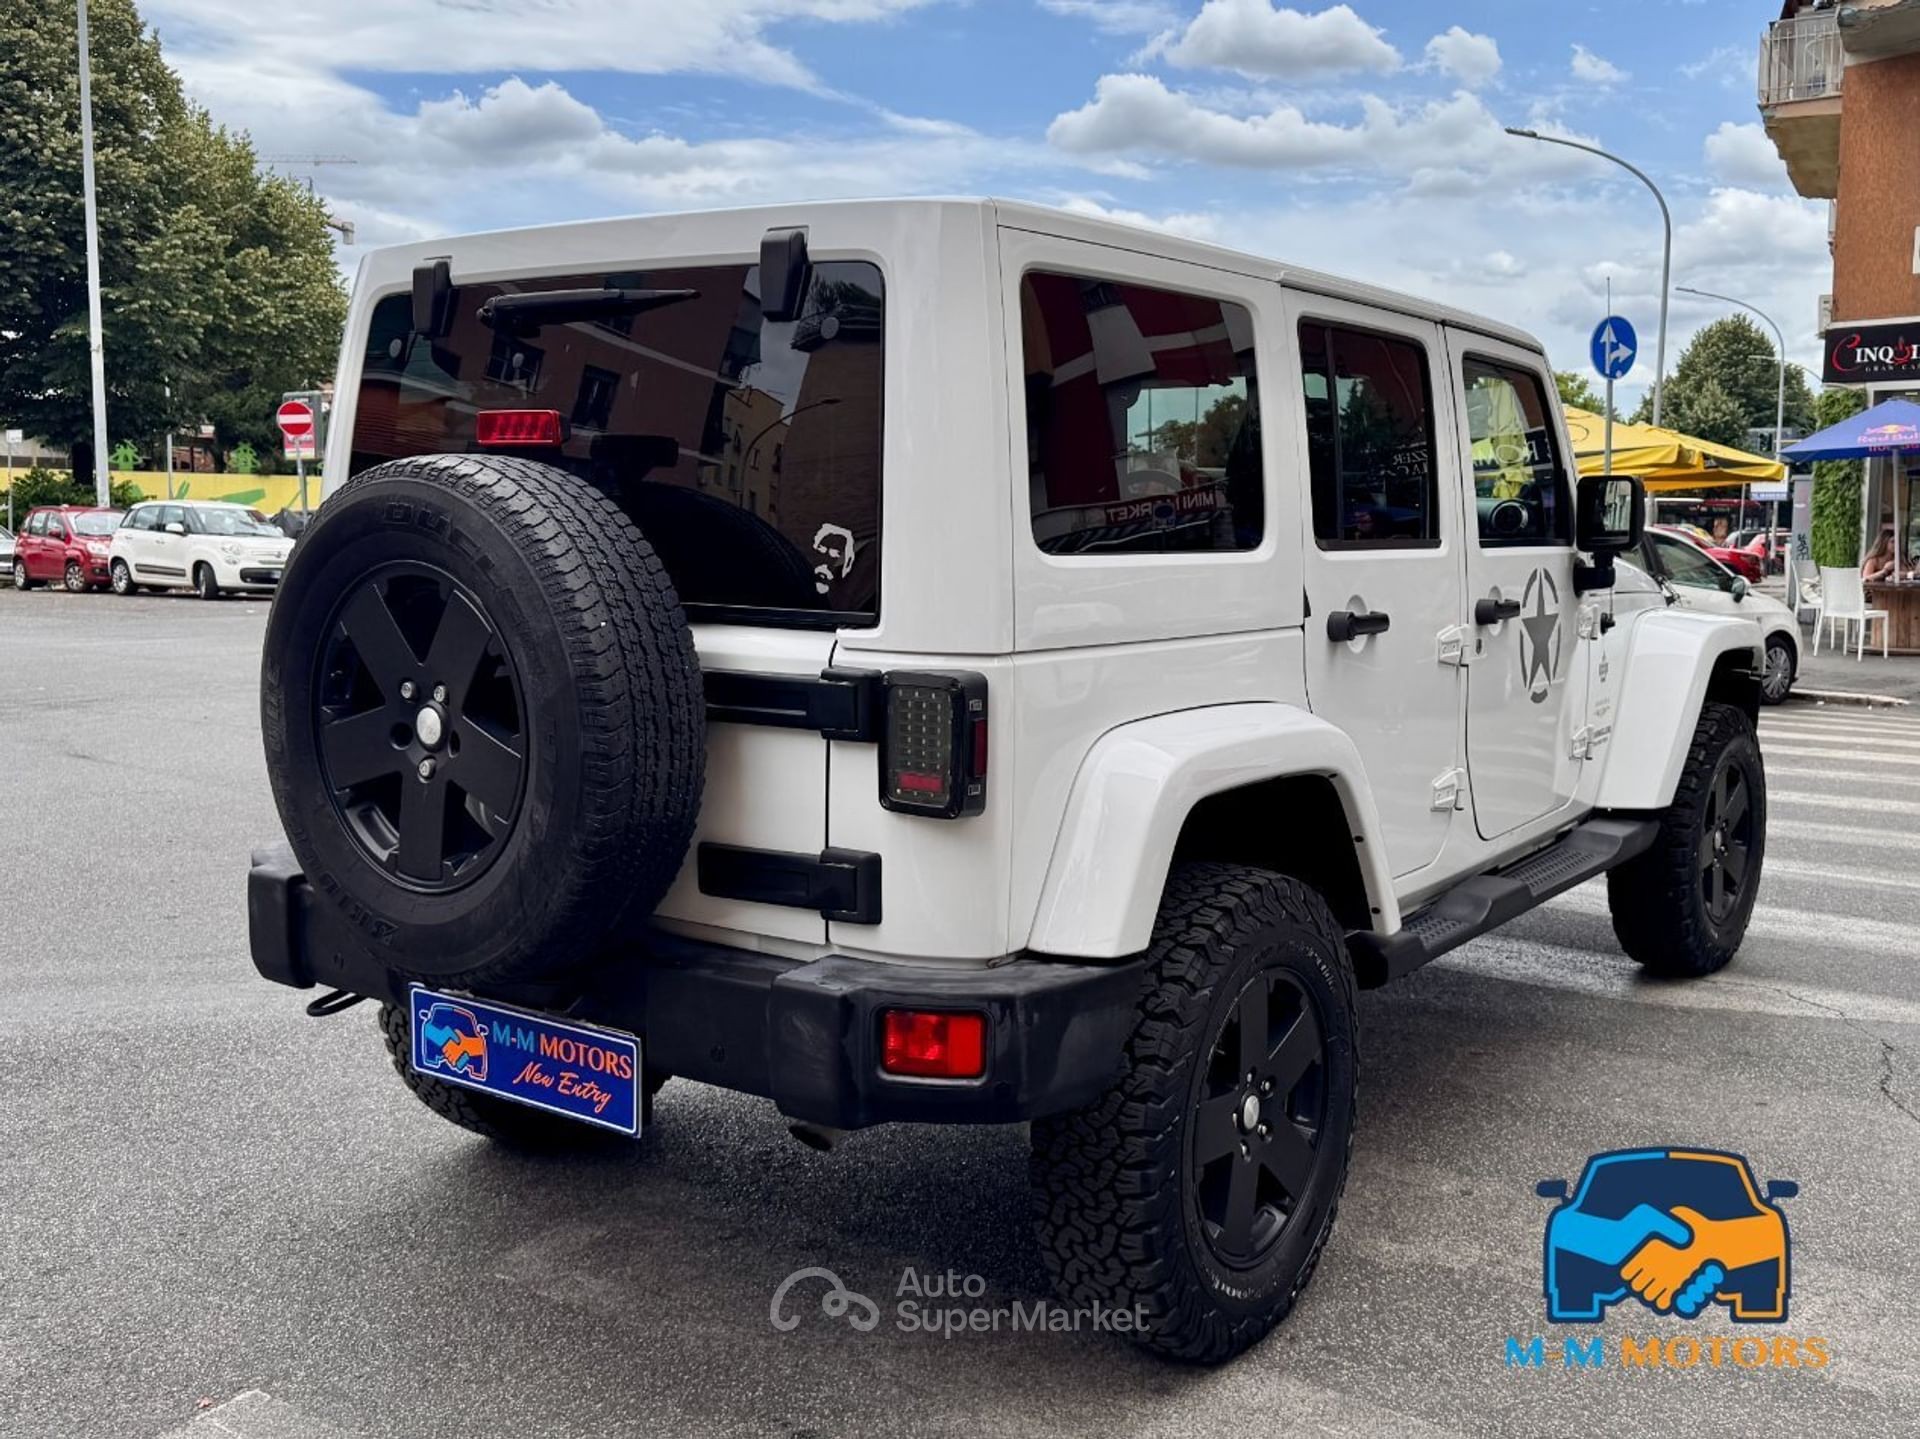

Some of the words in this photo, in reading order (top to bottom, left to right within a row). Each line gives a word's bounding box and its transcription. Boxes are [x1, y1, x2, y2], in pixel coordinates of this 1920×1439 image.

[491, 1021, 536, 1054] M-M
[540, 1034, 633, 1080] MOTORS
[513, 1062, 555, 1088] New
[557, 1071, 614, 1113] Entry
